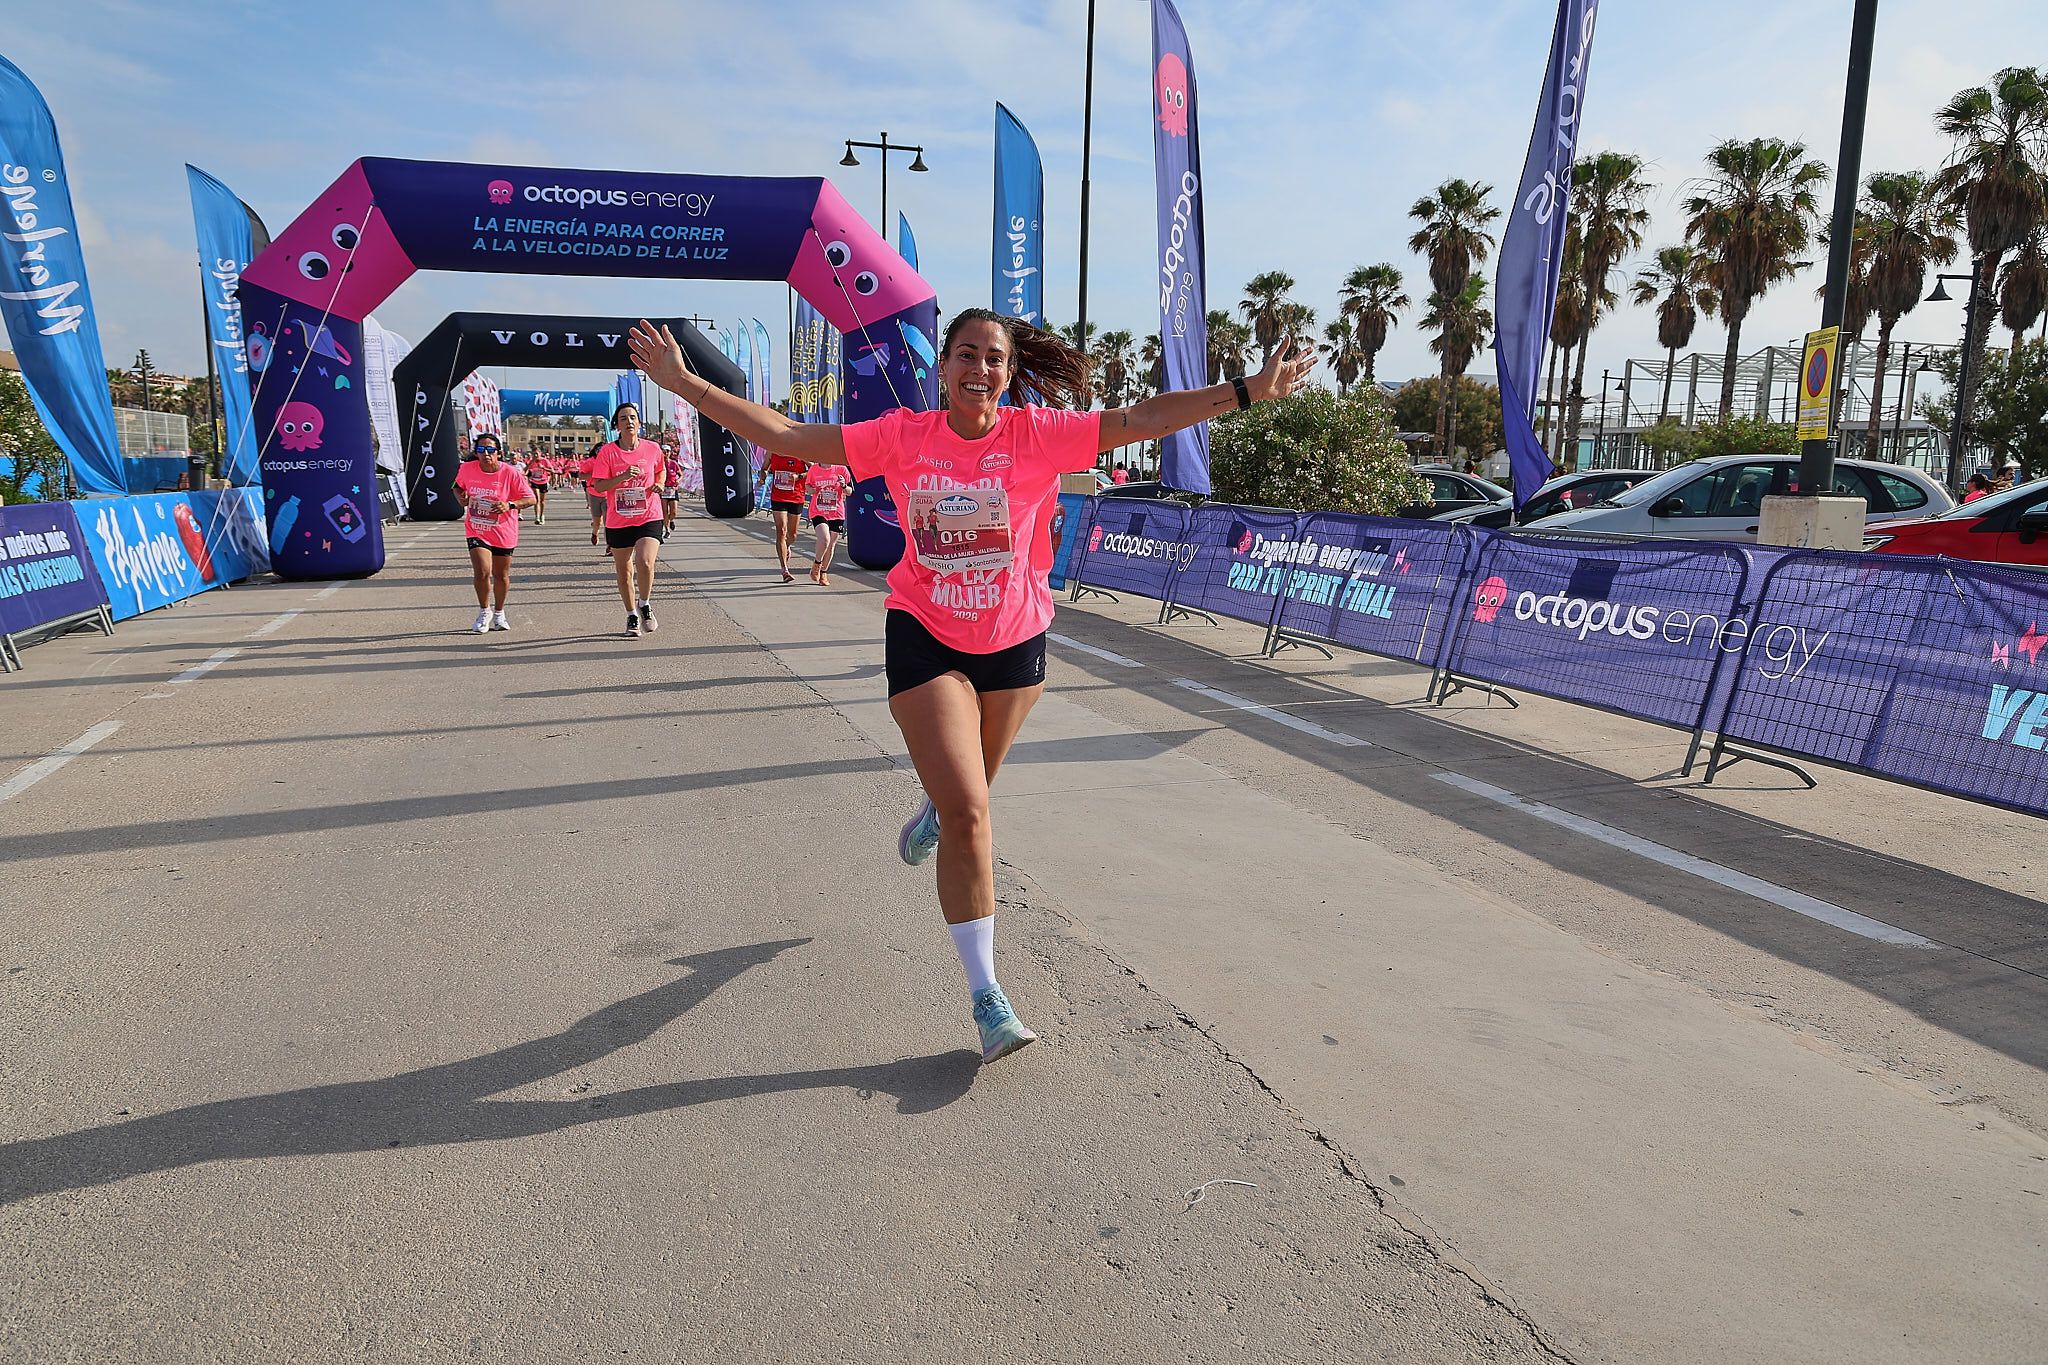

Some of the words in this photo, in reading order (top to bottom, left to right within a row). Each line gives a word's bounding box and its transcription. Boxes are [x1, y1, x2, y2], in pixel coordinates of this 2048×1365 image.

[473, 216, 498, 232] LA
[504, 217, 588, 236] ENERGÍA
[593, 223, 645, 239] PARA
[650, 225, 725, 242] CORRER
[473, 237, 487, 250] A
[492, 238, 516, 252] LA
[522, 240, 631, 257] VELOCIDAD
[636, 245, 660, 258] DE
[665, 246, 688, 258] LA
[693, 247, 728, 260] LUZ
[491, 330, 651, 348] VOLV
[534, 392, 580, 412] Marlene
[415, 391, 438, 505] VOLVO
[939, 503, 976, 511] ASTURIANA
[4, 531, 48, 559] metros
[940, 530, 978, 544] 016
[95, 506, 187, 613] Marlene
[957, 550, 975, 558] MUJER
[973, 558, 1001, 568] Santander
[1104, 532, 1154, 560] octopus
[1154, 541, 1200, 572] energy
[1250, 533, 1319, 567] Cogiendo
[1319, 544, 1388, 579] energía
[17, 555, 84, 593] CONSEGUIDO
[931, 581, 1000, 610] MUJER
[1227, 562, 1263, 592] PARA
[1262, 567, 1286, 596] TU
[1284, 570, 1343, 606] SPRINT
[1339, 578, 1397, 620] FINAL
[1514, 590, 1659, 641] octopus
[1661, 610, 1830, 683] energy
